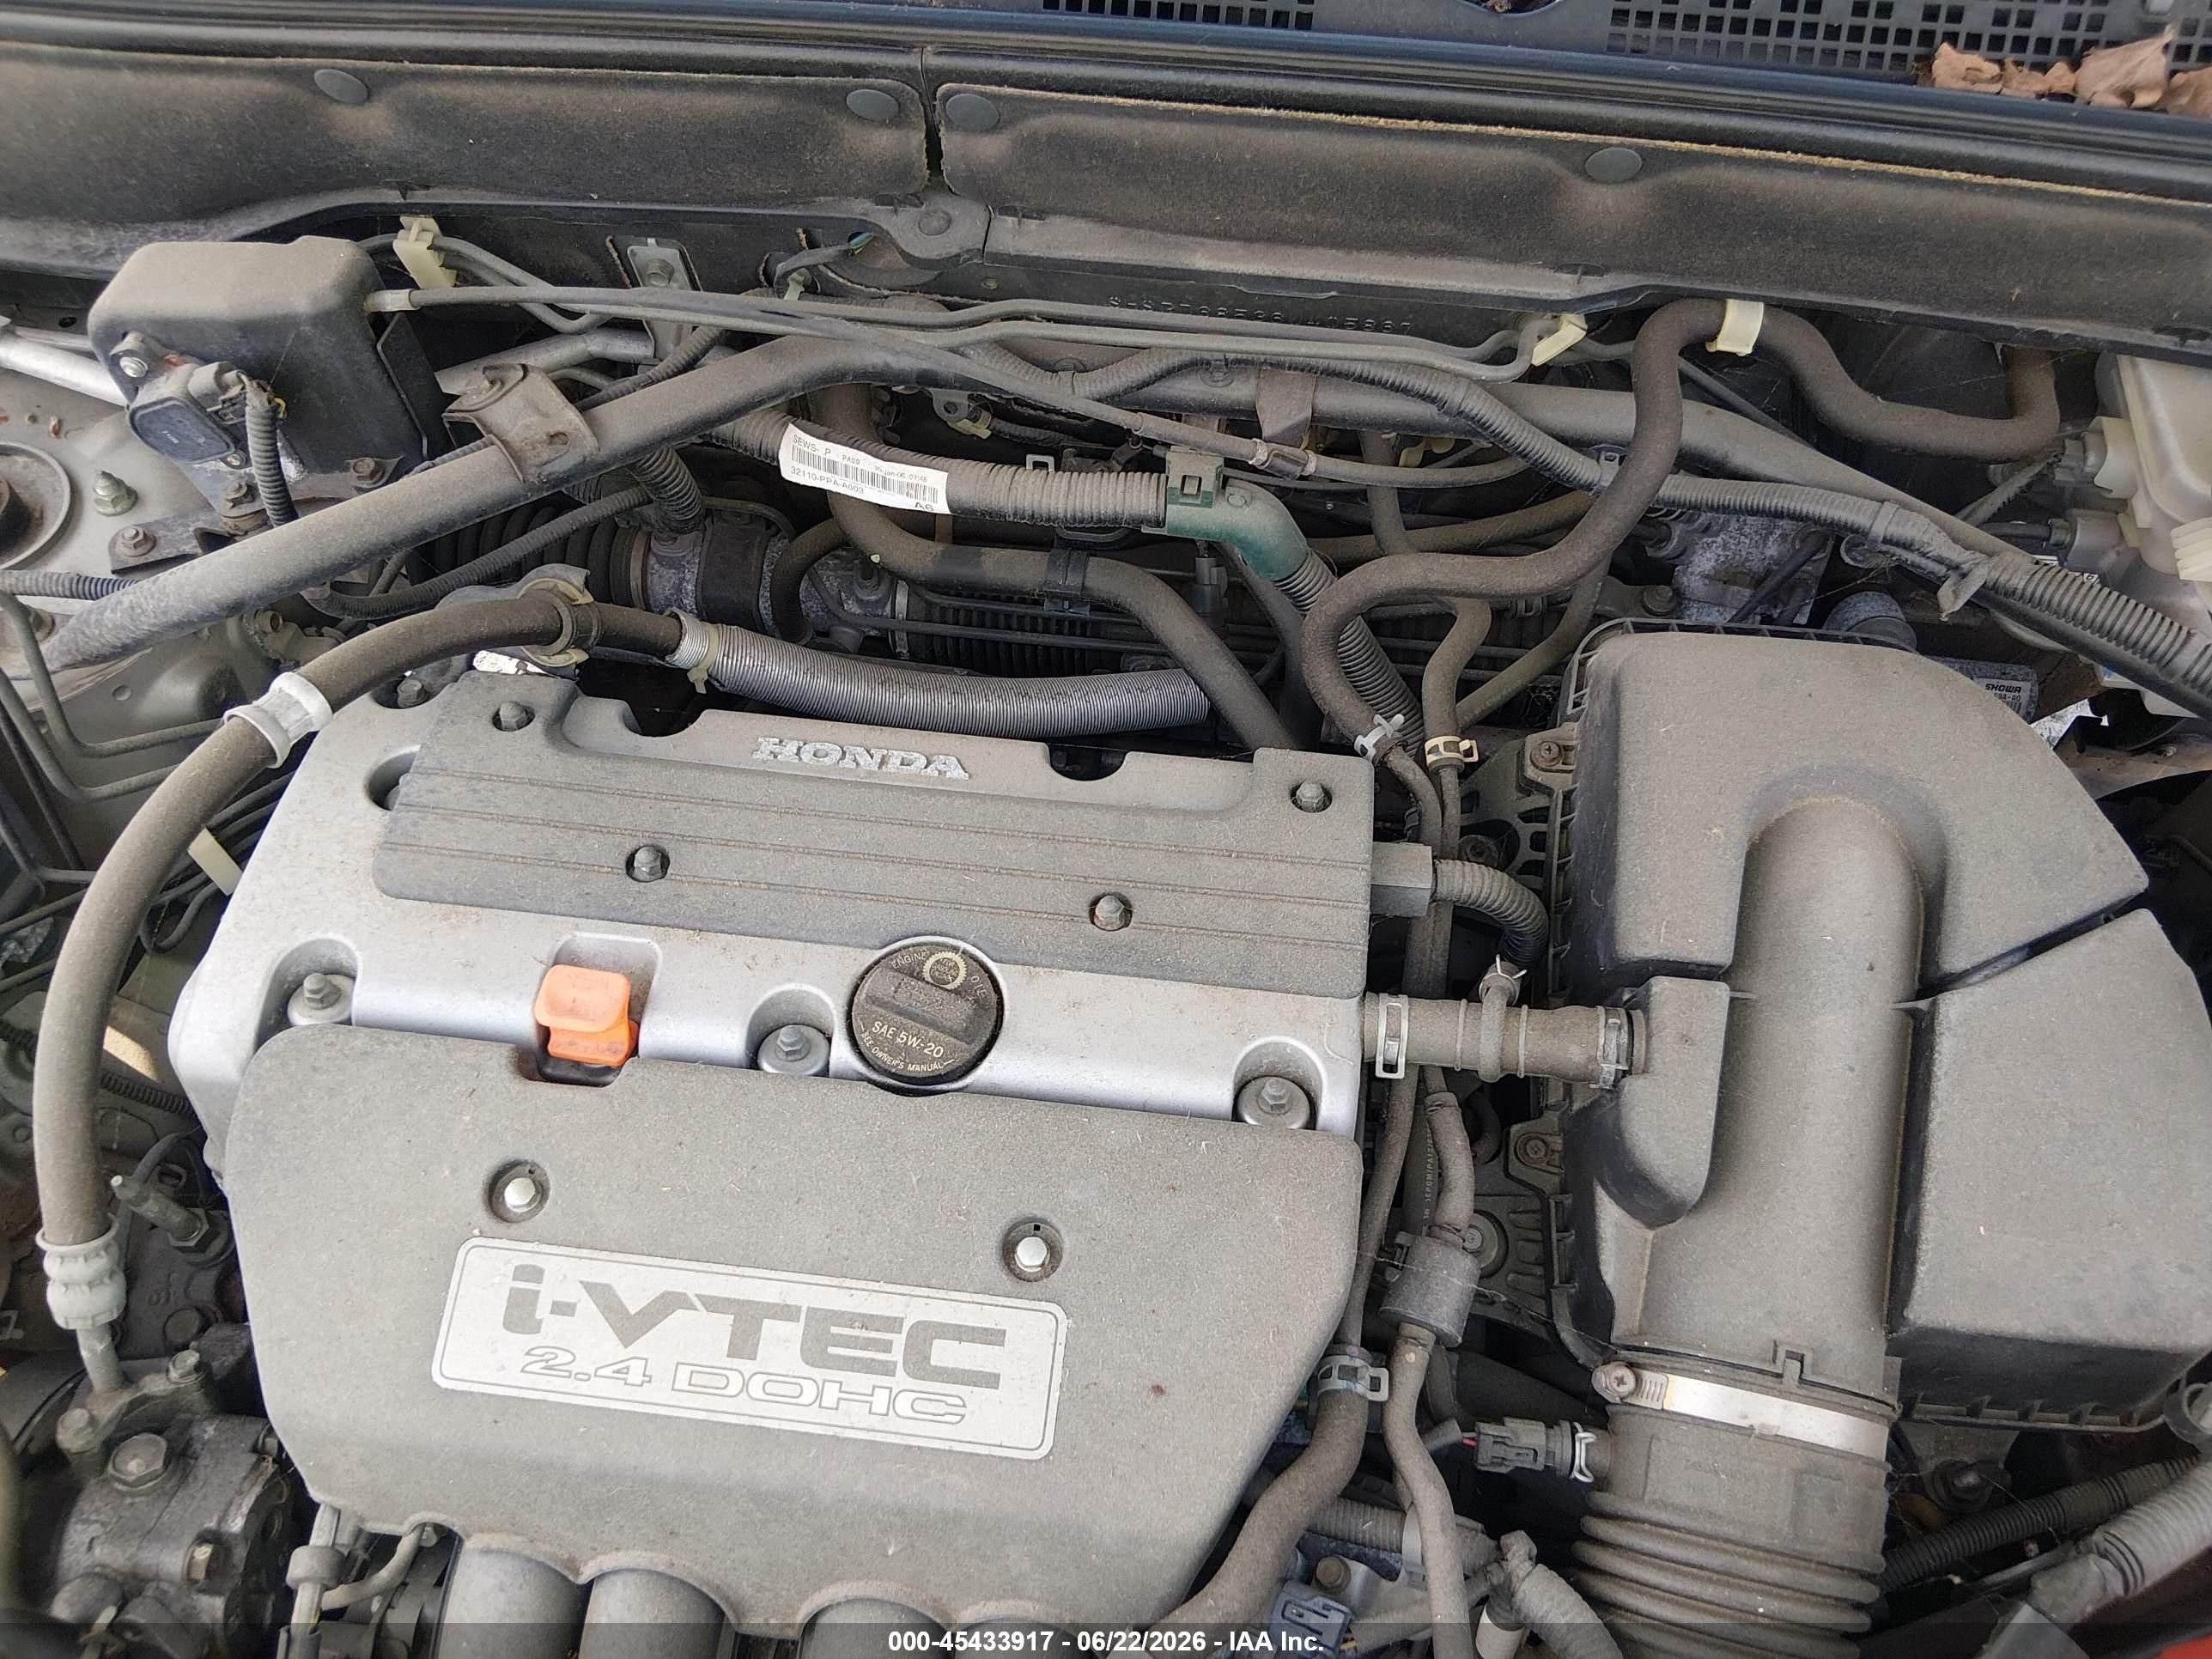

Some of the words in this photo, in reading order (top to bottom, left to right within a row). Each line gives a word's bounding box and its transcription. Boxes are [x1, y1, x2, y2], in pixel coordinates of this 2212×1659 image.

[842, 455, 860, 465] PASS
[915, 501, 935, 512] A6
[1985, 684, 2021, 693] SHOWA
[752, 736, 970, 781] HONDA
[890, 951, 927, 969] ENGINE
[861, 1031, 872, 1048] SEE
[872, 1046, 904, 1069] OWNER'S
[908, 1061, 945, 1073] MANUAL
[872, 1021, 897, 1039] SAE
[898, 1030, 945, 1058] 5W-20
[501, 1263, 1007, 1390] i-VTEC
[520, 1345, 652, 1387] 2.4
[671, 1361, 967, 1425] DOHC
